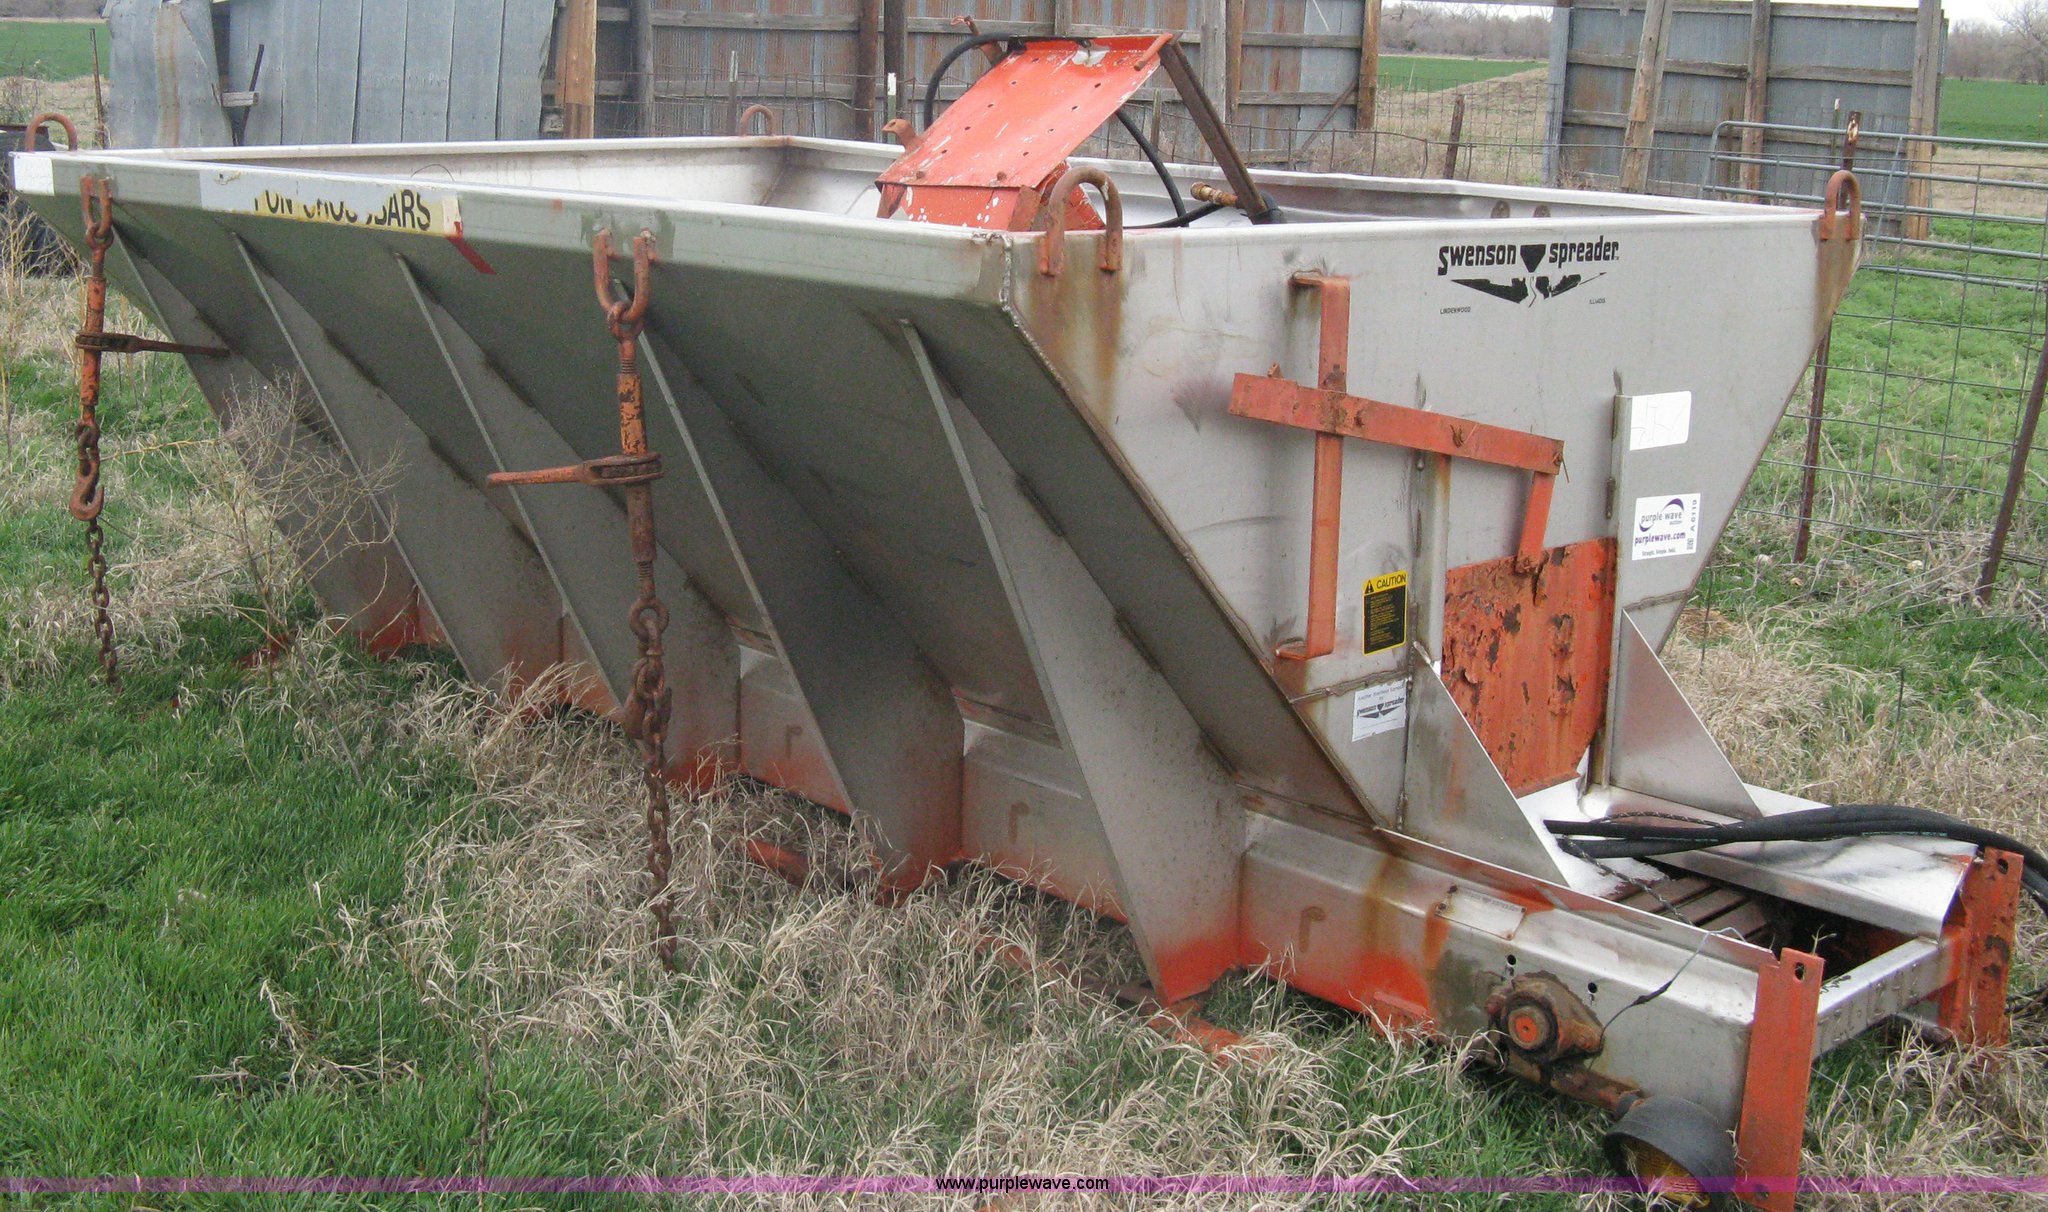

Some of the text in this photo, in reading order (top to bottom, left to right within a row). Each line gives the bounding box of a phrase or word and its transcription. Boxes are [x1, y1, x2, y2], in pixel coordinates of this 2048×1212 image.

[1438, 235, 1619, 276] Swenson spreader
[1641, 512, 1662, 524] purple
[1664, 511, 1682, 520] wave
[1635, 532, 1686, 547] purplewave.com
[1376, 574, 1406, 589] CAUTION
